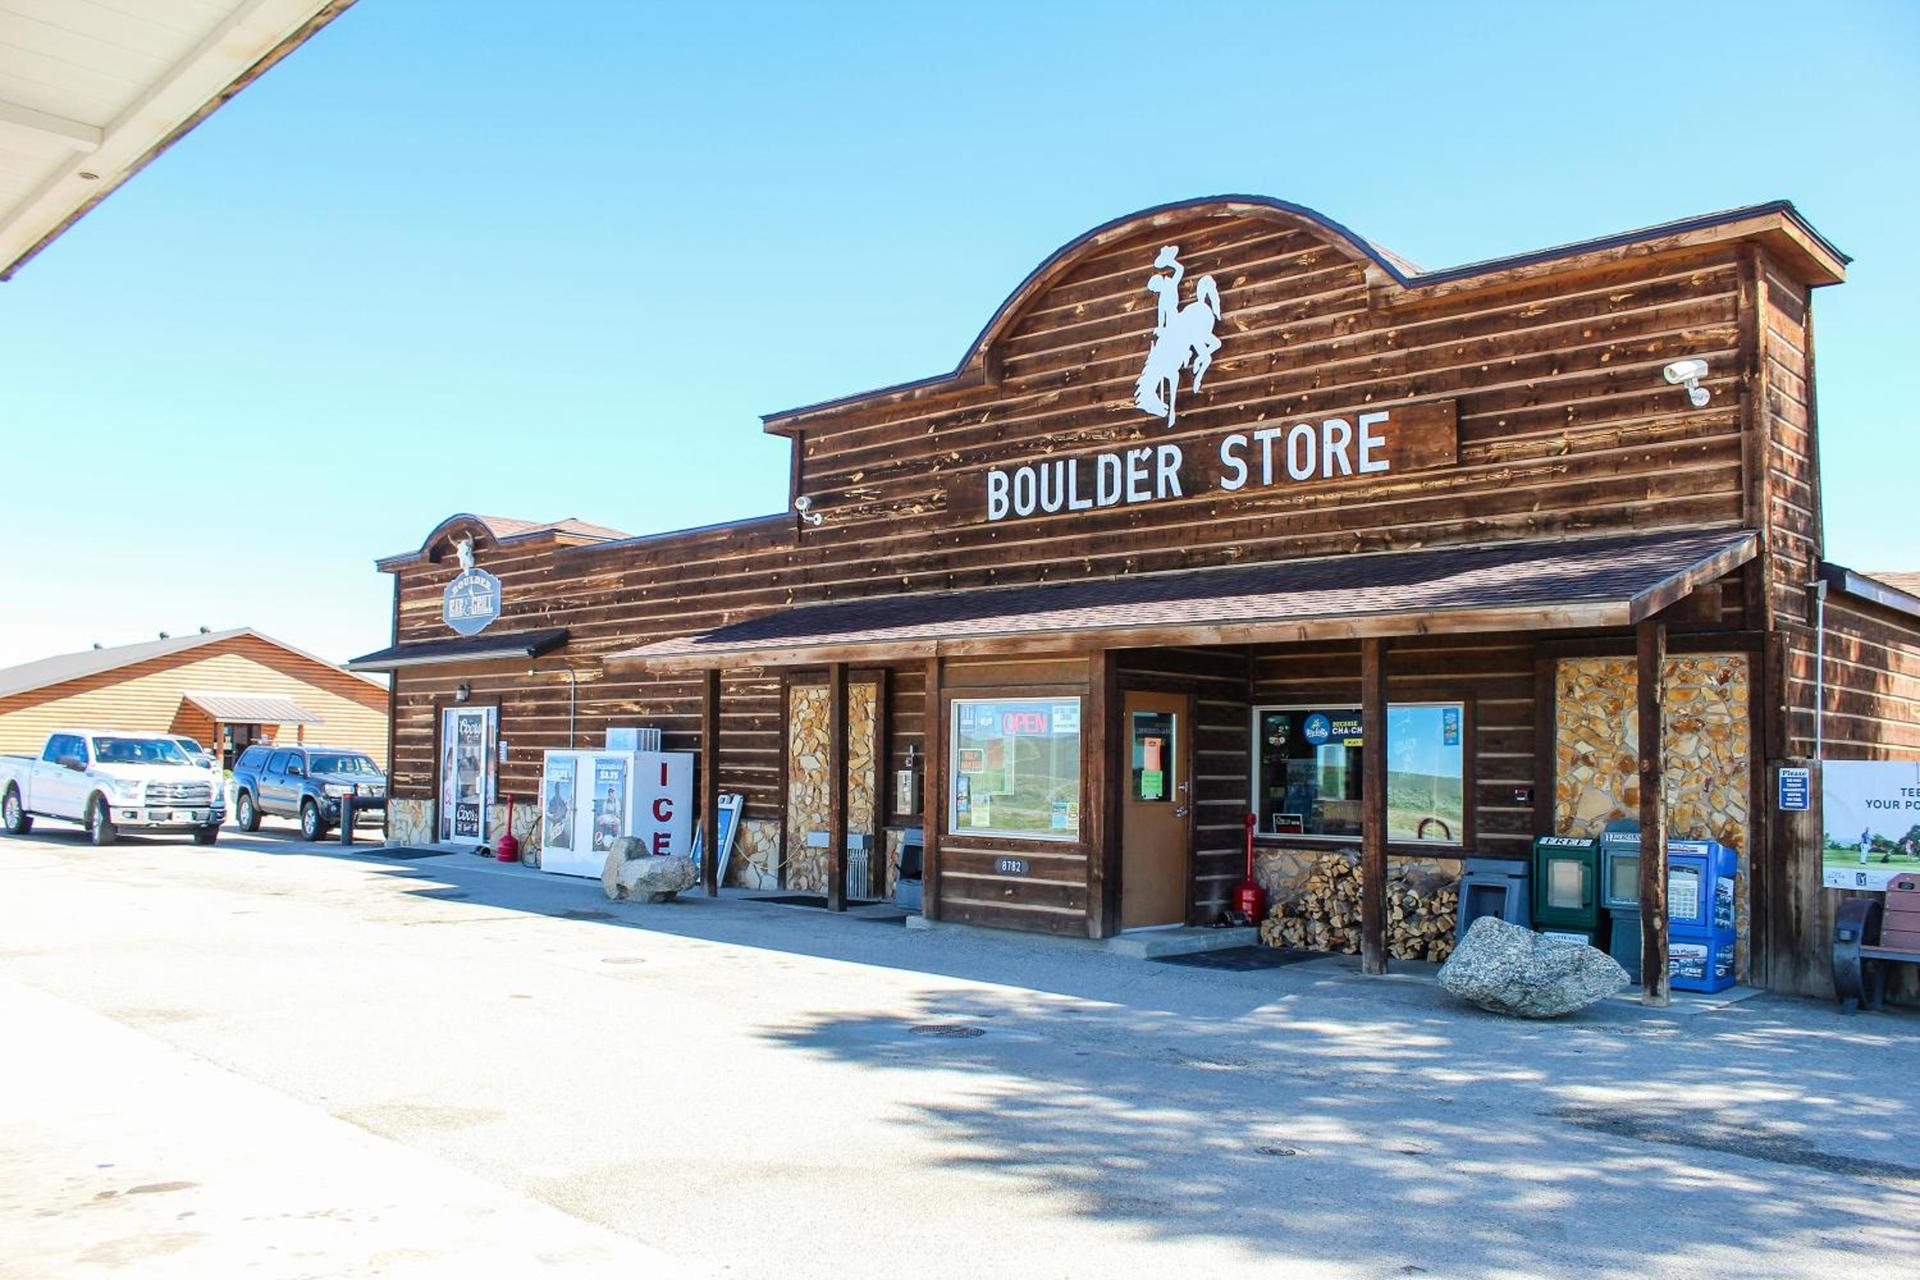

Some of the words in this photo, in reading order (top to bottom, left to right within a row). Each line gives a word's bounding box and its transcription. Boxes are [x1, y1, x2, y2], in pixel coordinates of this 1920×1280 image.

[987, 444, 1184, 521] BOULDER
[1220, 411, 1391, 491] STORE
[1002, 711, 1048, 736] OPEN
[652, 761, 674, 857] ICE
[1865, 799, 1900, 810] YOUR
[1001, 859, 1021, 873] 8782
